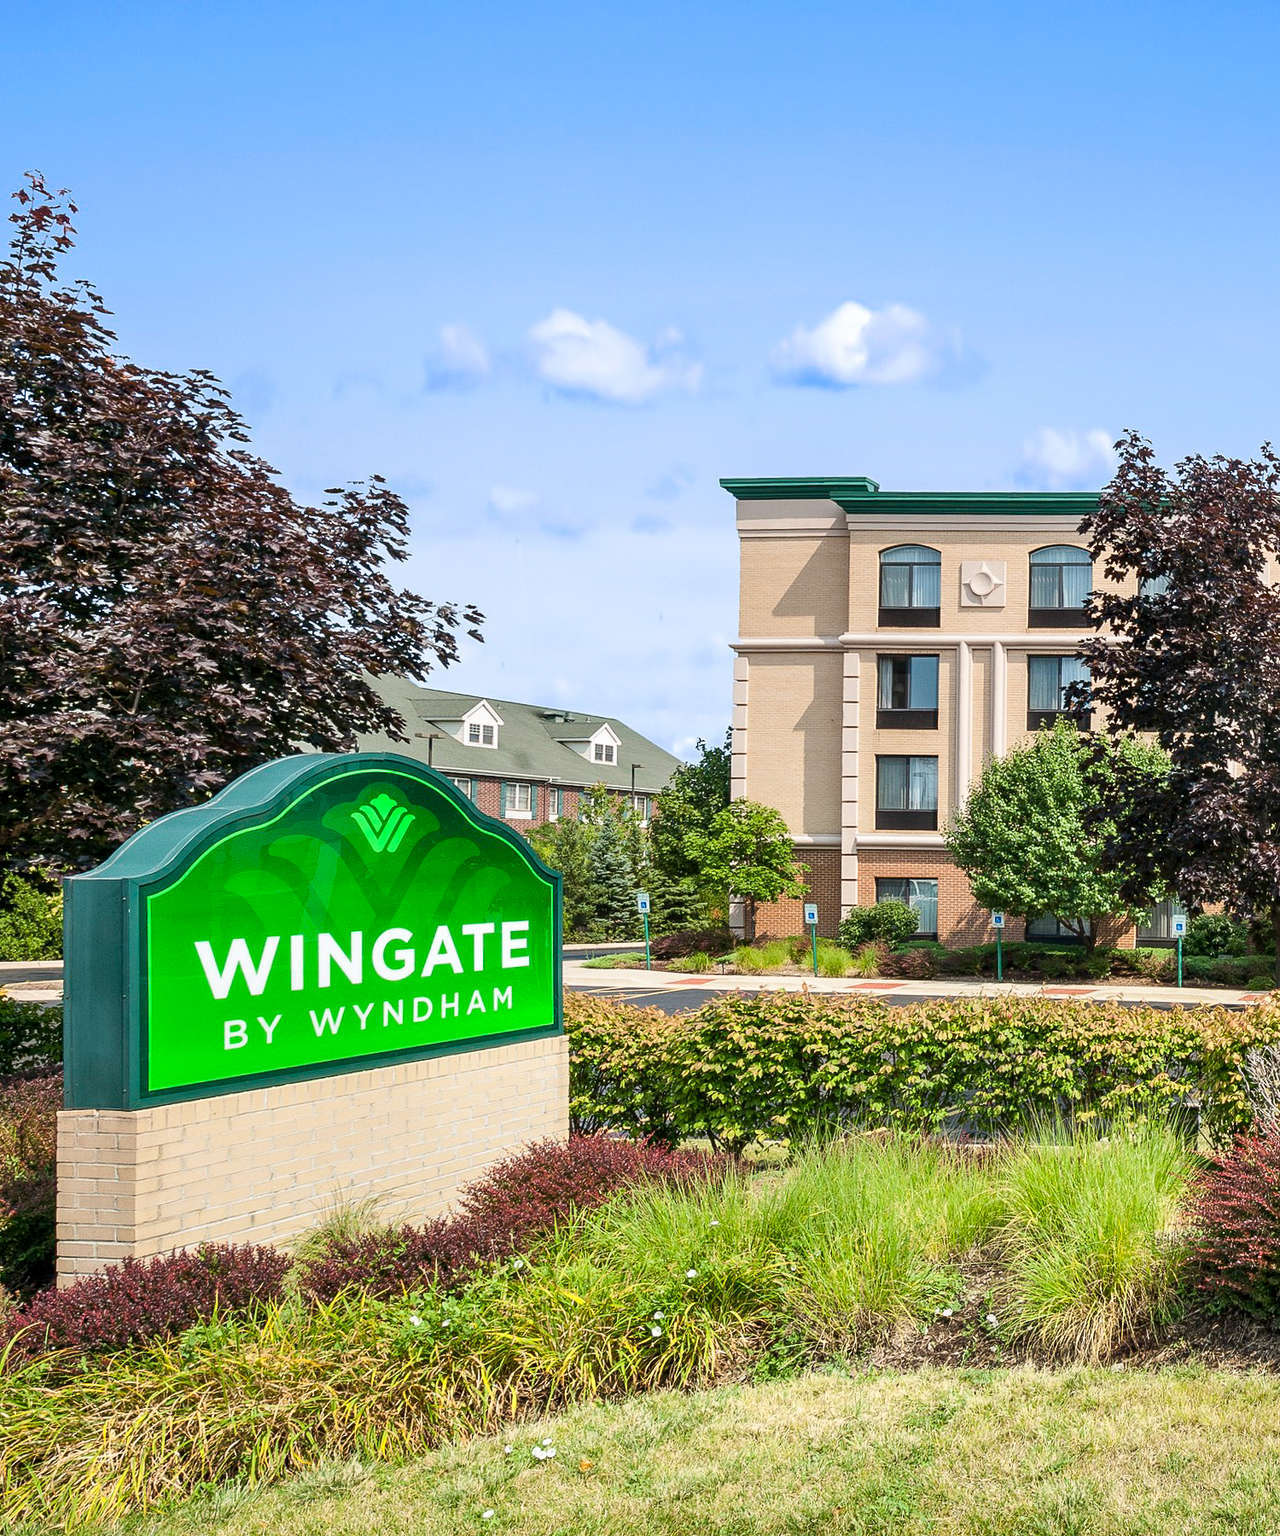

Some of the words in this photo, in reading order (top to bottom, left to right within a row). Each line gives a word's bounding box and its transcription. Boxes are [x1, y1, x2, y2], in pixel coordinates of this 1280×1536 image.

[194, 920, 530, 1000] WINGATE
[223, 1014, 282, 1050] BY
[309, 986, 513, 1037] WYNDHAM
